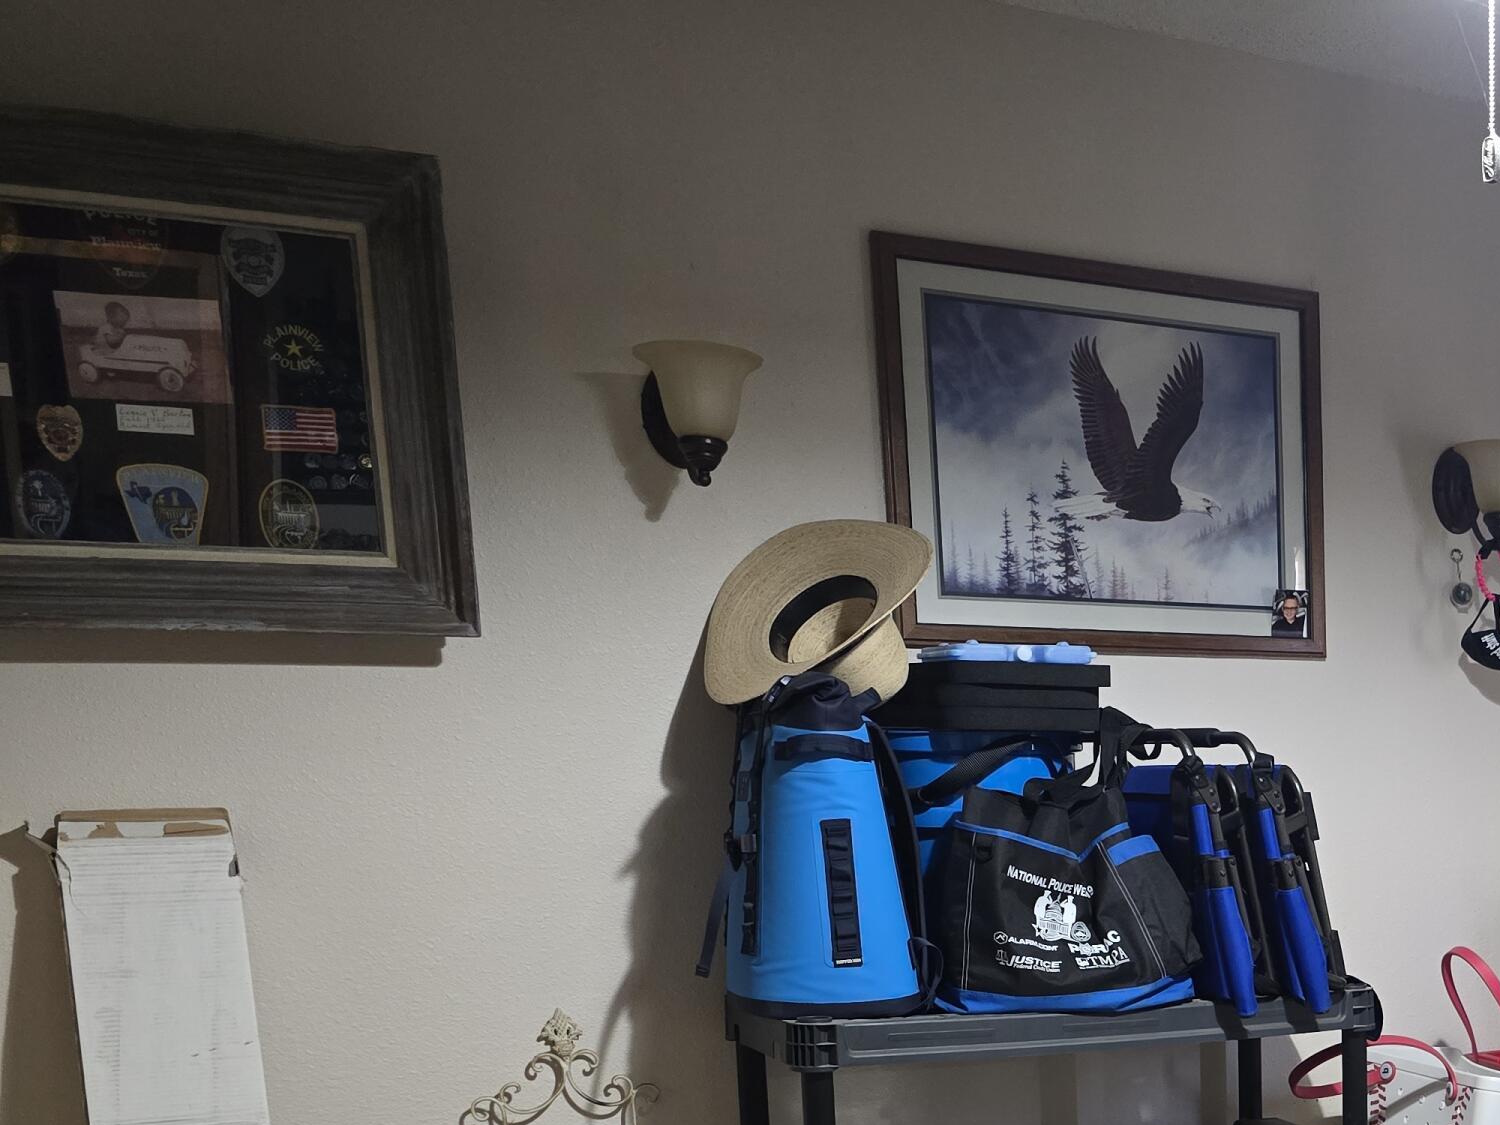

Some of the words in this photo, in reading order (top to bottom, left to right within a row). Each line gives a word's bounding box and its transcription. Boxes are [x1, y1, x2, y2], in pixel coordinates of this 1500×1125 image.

[263, 324, 324, 352] PLAINVIEW
[270, 352, 320, 370] POLICE
[1007, 864, 1047, 889] NATIONAL
[1047, 878, 1074, 894] POLICE
[1006, 955, 1062, 967] JUSTICE
